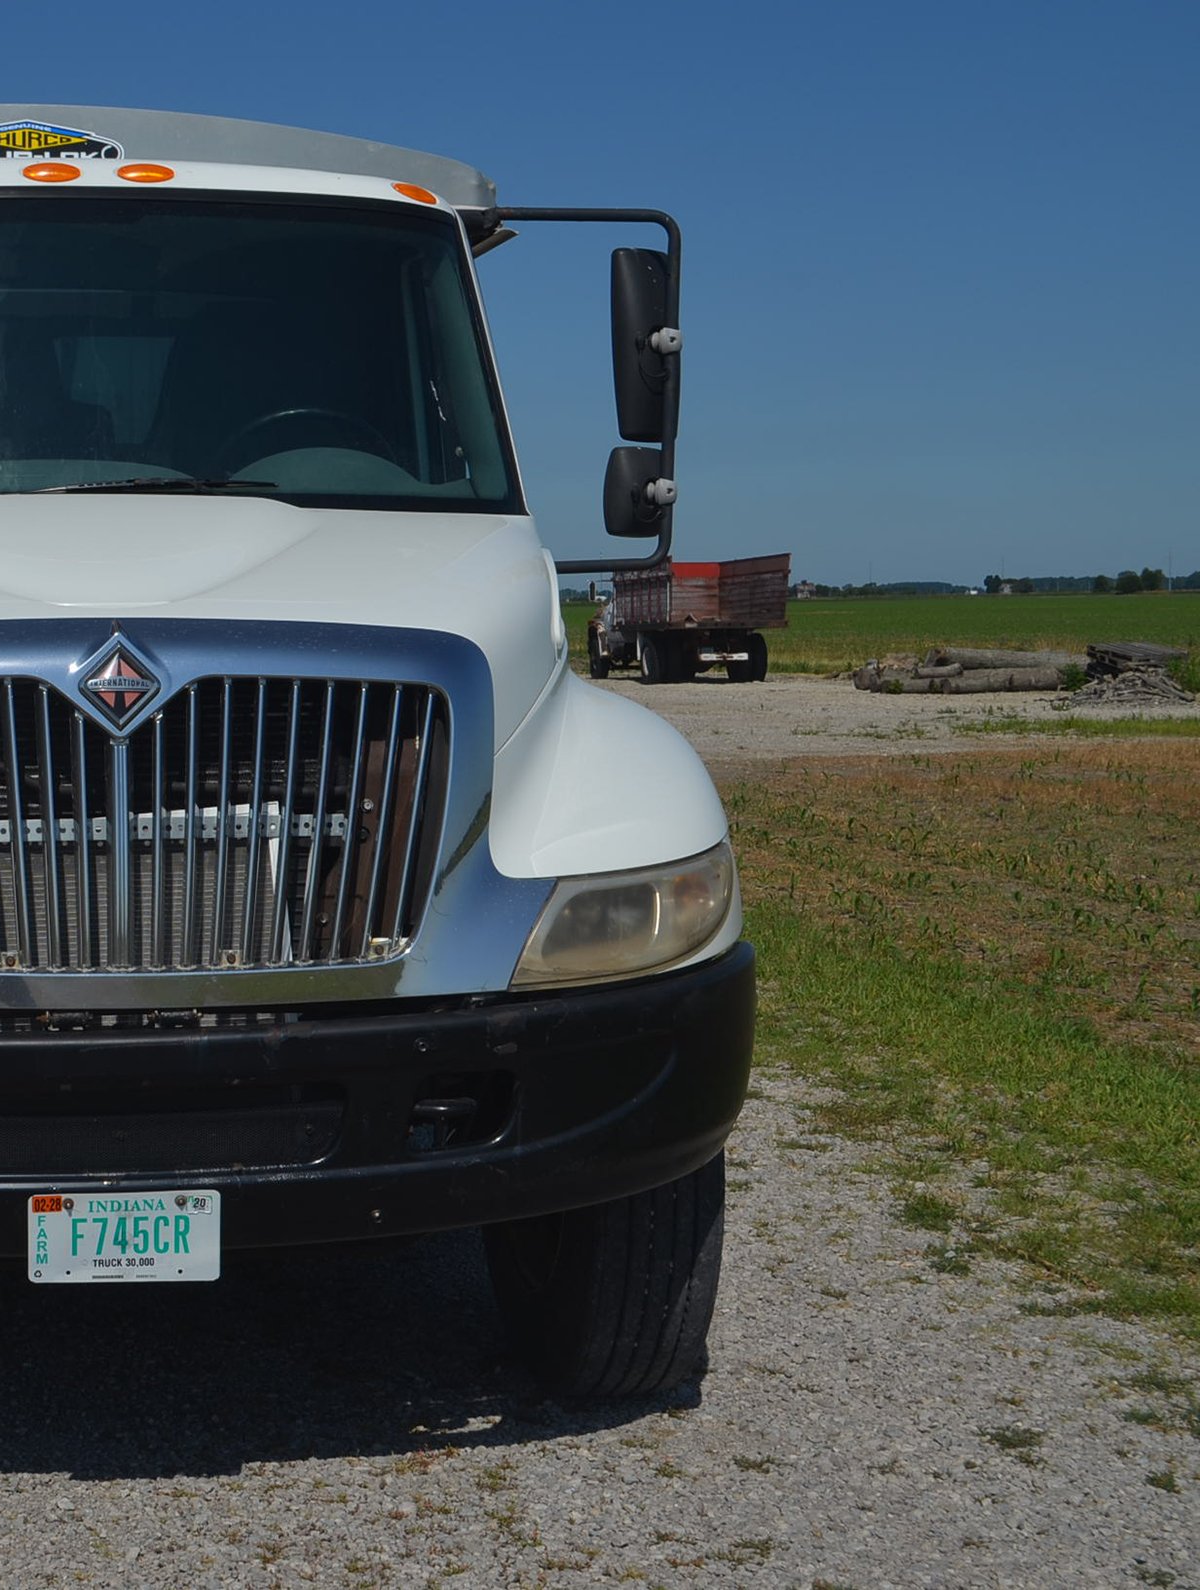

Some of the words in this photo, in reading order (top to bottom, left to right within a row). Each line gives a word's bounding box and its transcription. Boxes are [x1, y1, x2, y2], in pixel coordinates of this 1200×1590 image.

[90, 678, 149, 687] INTERNATIONAL
[34, 1197, 61, 1212] 02-28
[89, 1199, 165, 1213] INDIANA
[193, 1197, 207, 1209] 20
[36, 1215, 48, 1264] FARM
[71, 1215, 190, 1256] F745CR
[93, 1259, 123, 1268] TRUCK
[125, 1258, 155, 1268] 30,000
